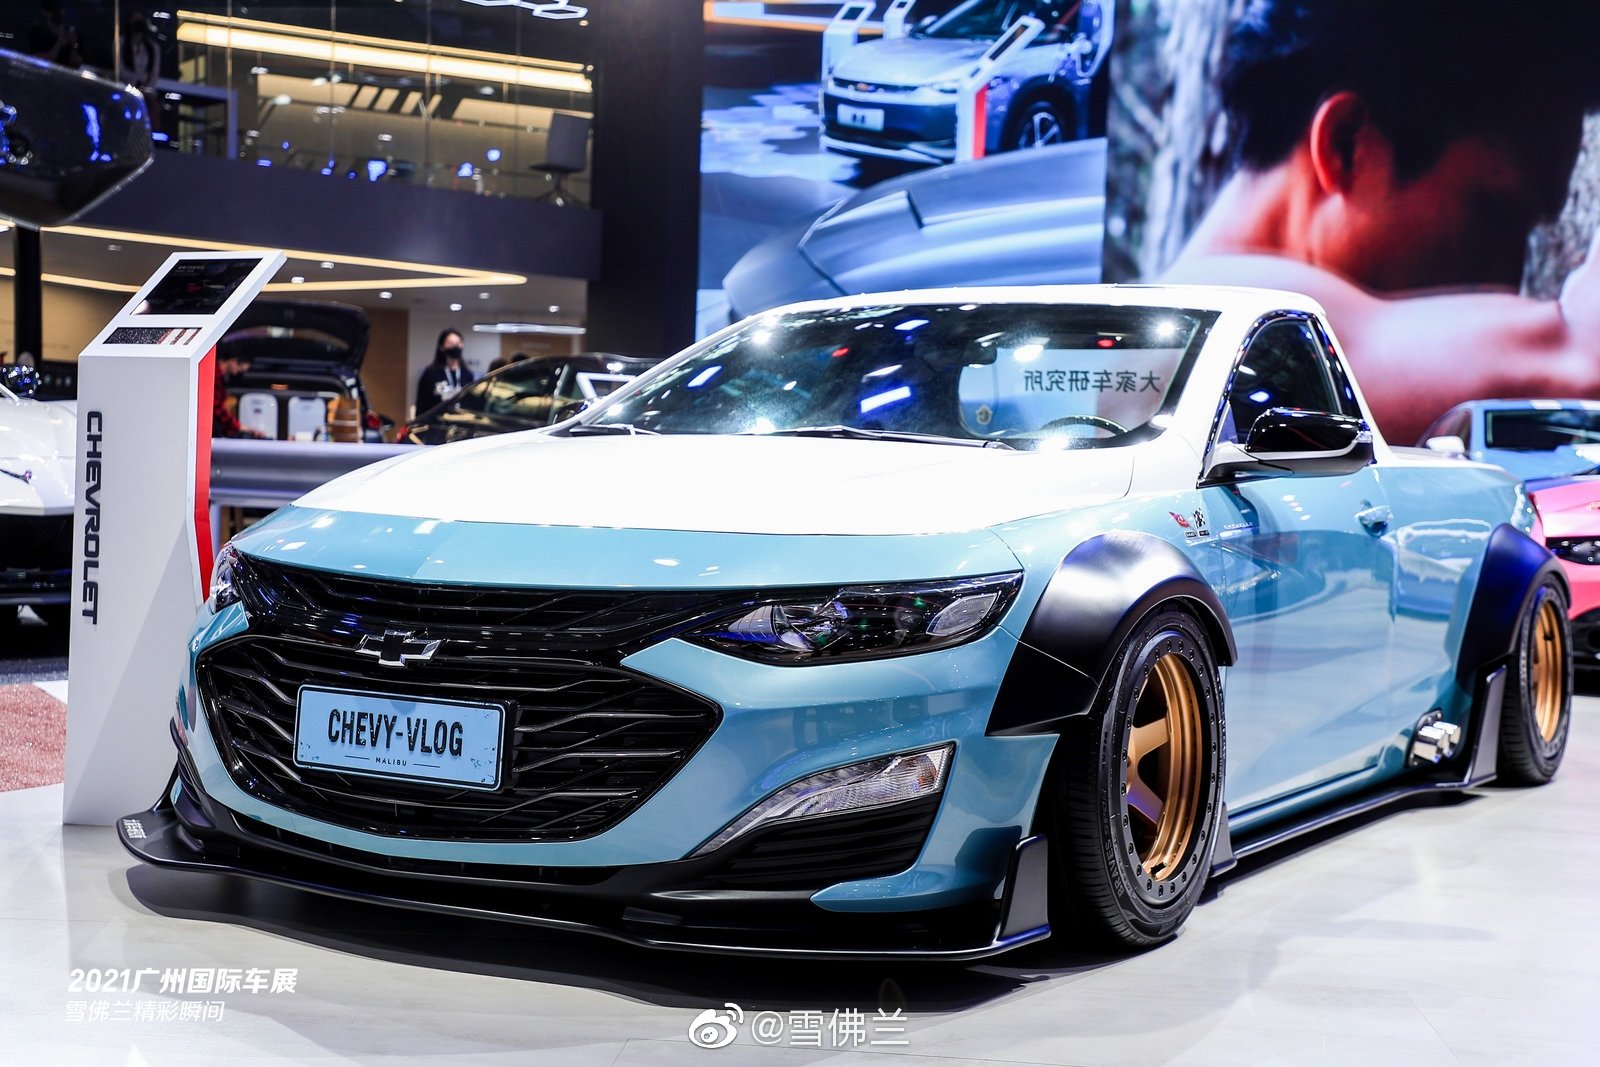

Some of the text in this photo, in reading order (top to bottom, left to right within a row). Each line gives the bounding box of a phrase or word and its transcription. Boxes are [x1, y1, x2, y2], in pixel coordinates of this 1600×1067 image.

[82, 410, 103, 625] CHEVROLET
[327, 708, 464, 757] CHEVY-VLOG
[375, 757, 408, 767] MALIBU
[1105, 839, 1125, 897] BRAVES
